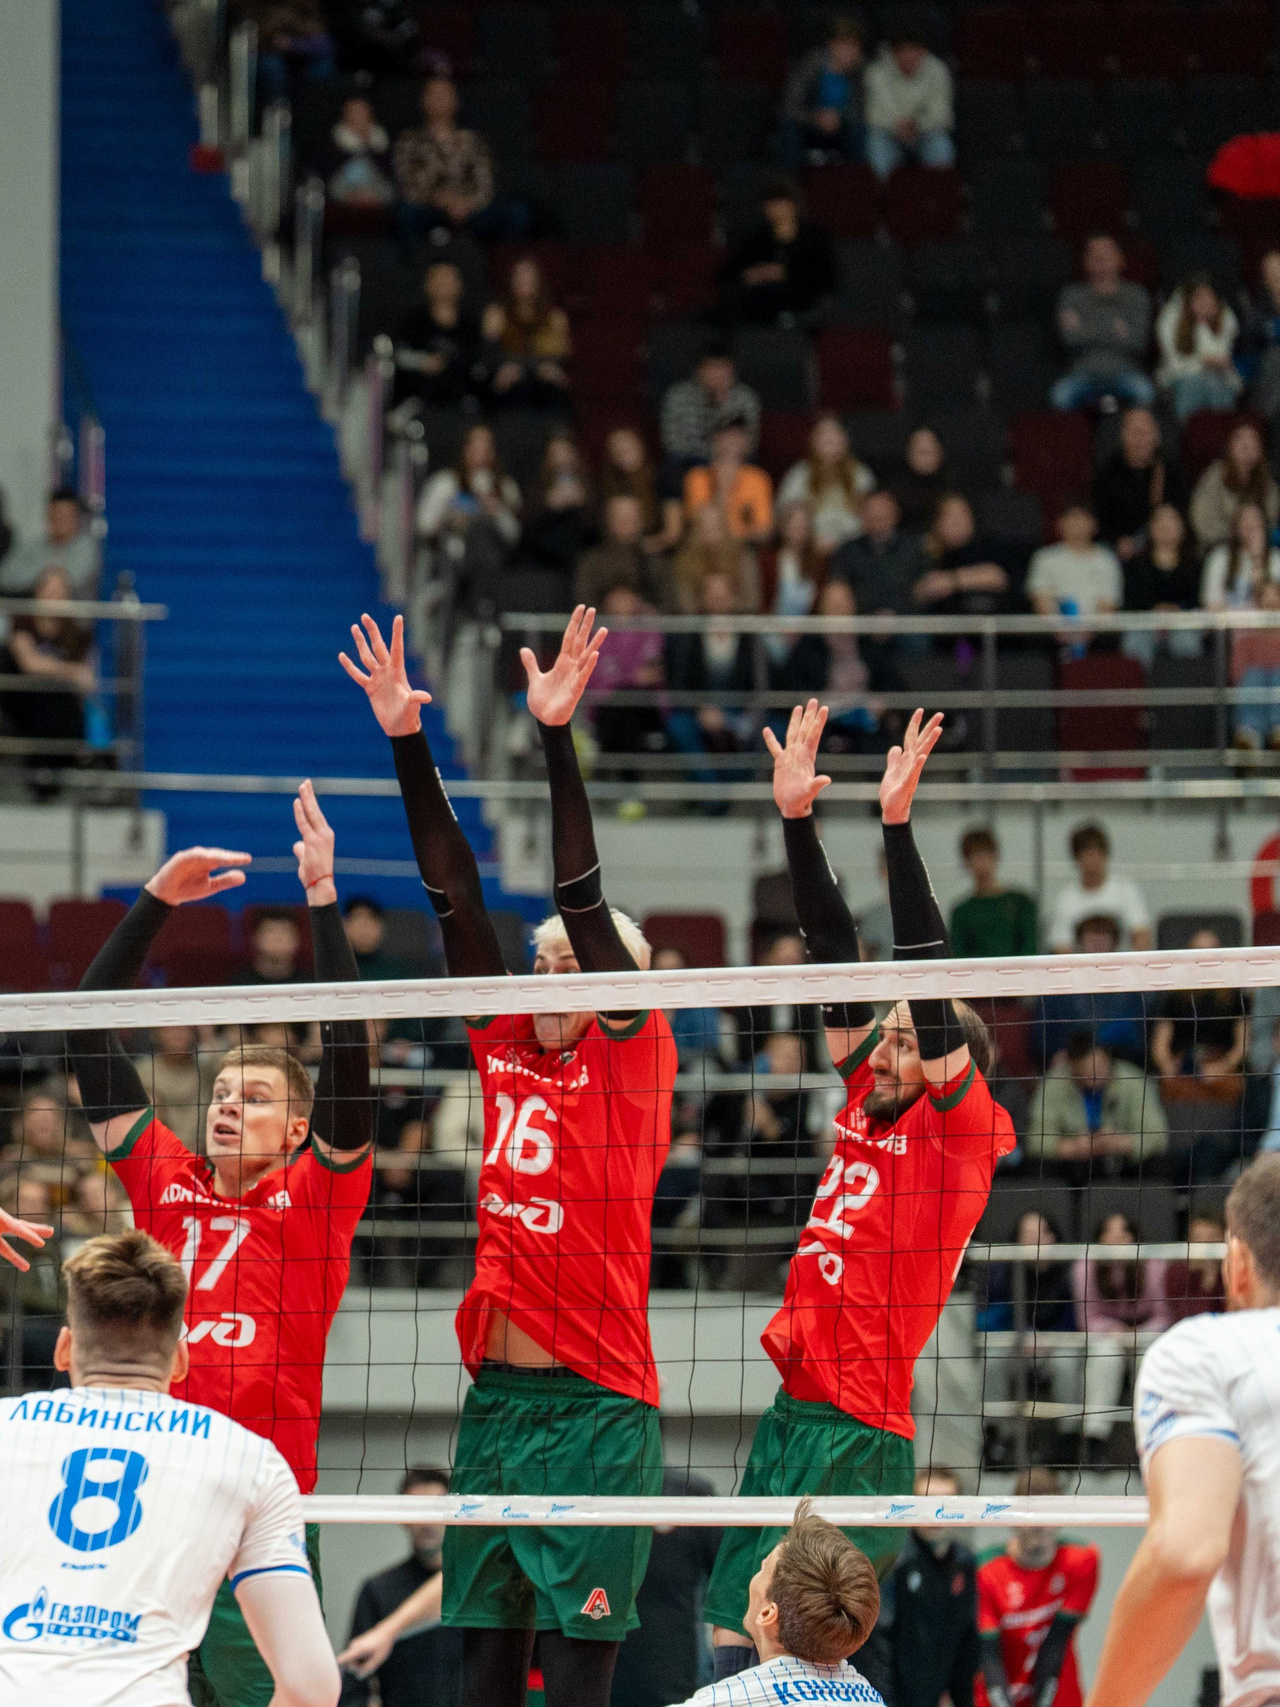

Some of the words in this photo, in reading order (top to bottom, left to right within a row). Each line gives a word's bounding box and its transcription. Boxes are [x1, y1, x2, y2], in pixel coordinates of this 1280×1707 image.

[484, 1091, 558, 1176] 16
[807, 1154, 880, 1241] 22
[180, 1215, 252, 1291] 17
[48, 1447, 149, 1552] 8
[49, 1602, 143, 1631] ГАЗПРОМ
